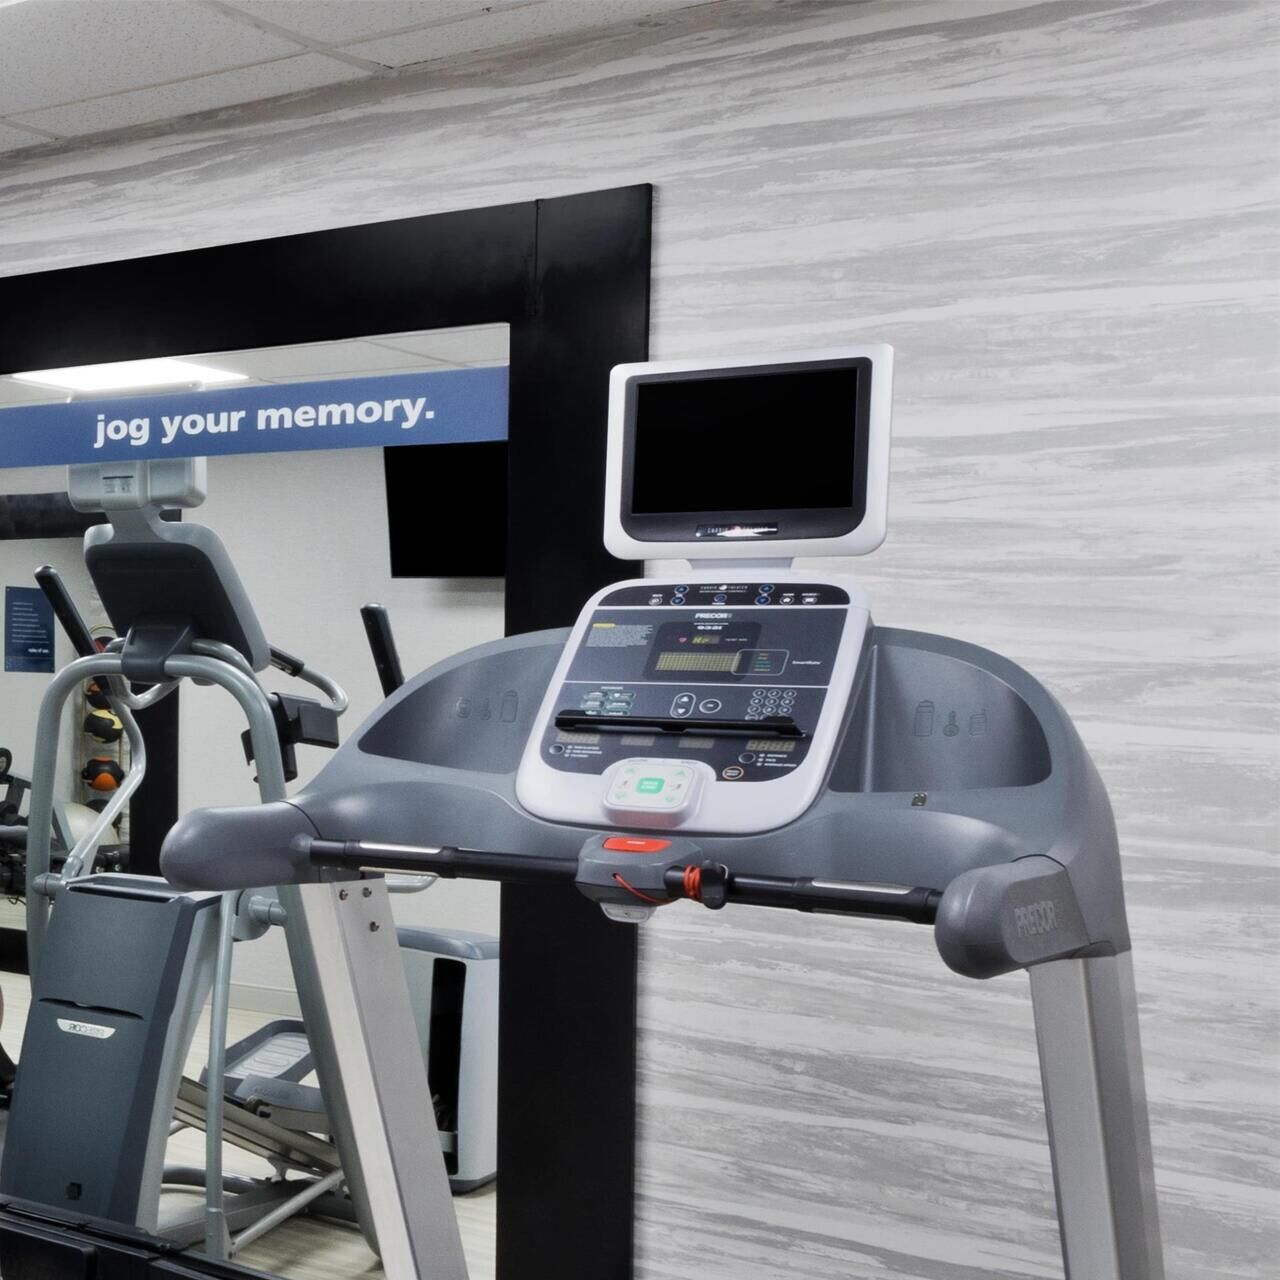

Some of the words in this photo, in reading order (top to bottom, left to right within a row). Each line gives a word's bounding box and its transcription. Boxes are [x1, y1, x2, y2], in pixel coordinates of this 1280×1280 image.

[93, 413, 149, 448] jog
[161, 409, 245, 444] your
[256, 396, 435, 430] memory.
[1014, 901, 1057, 937] PRECOR
